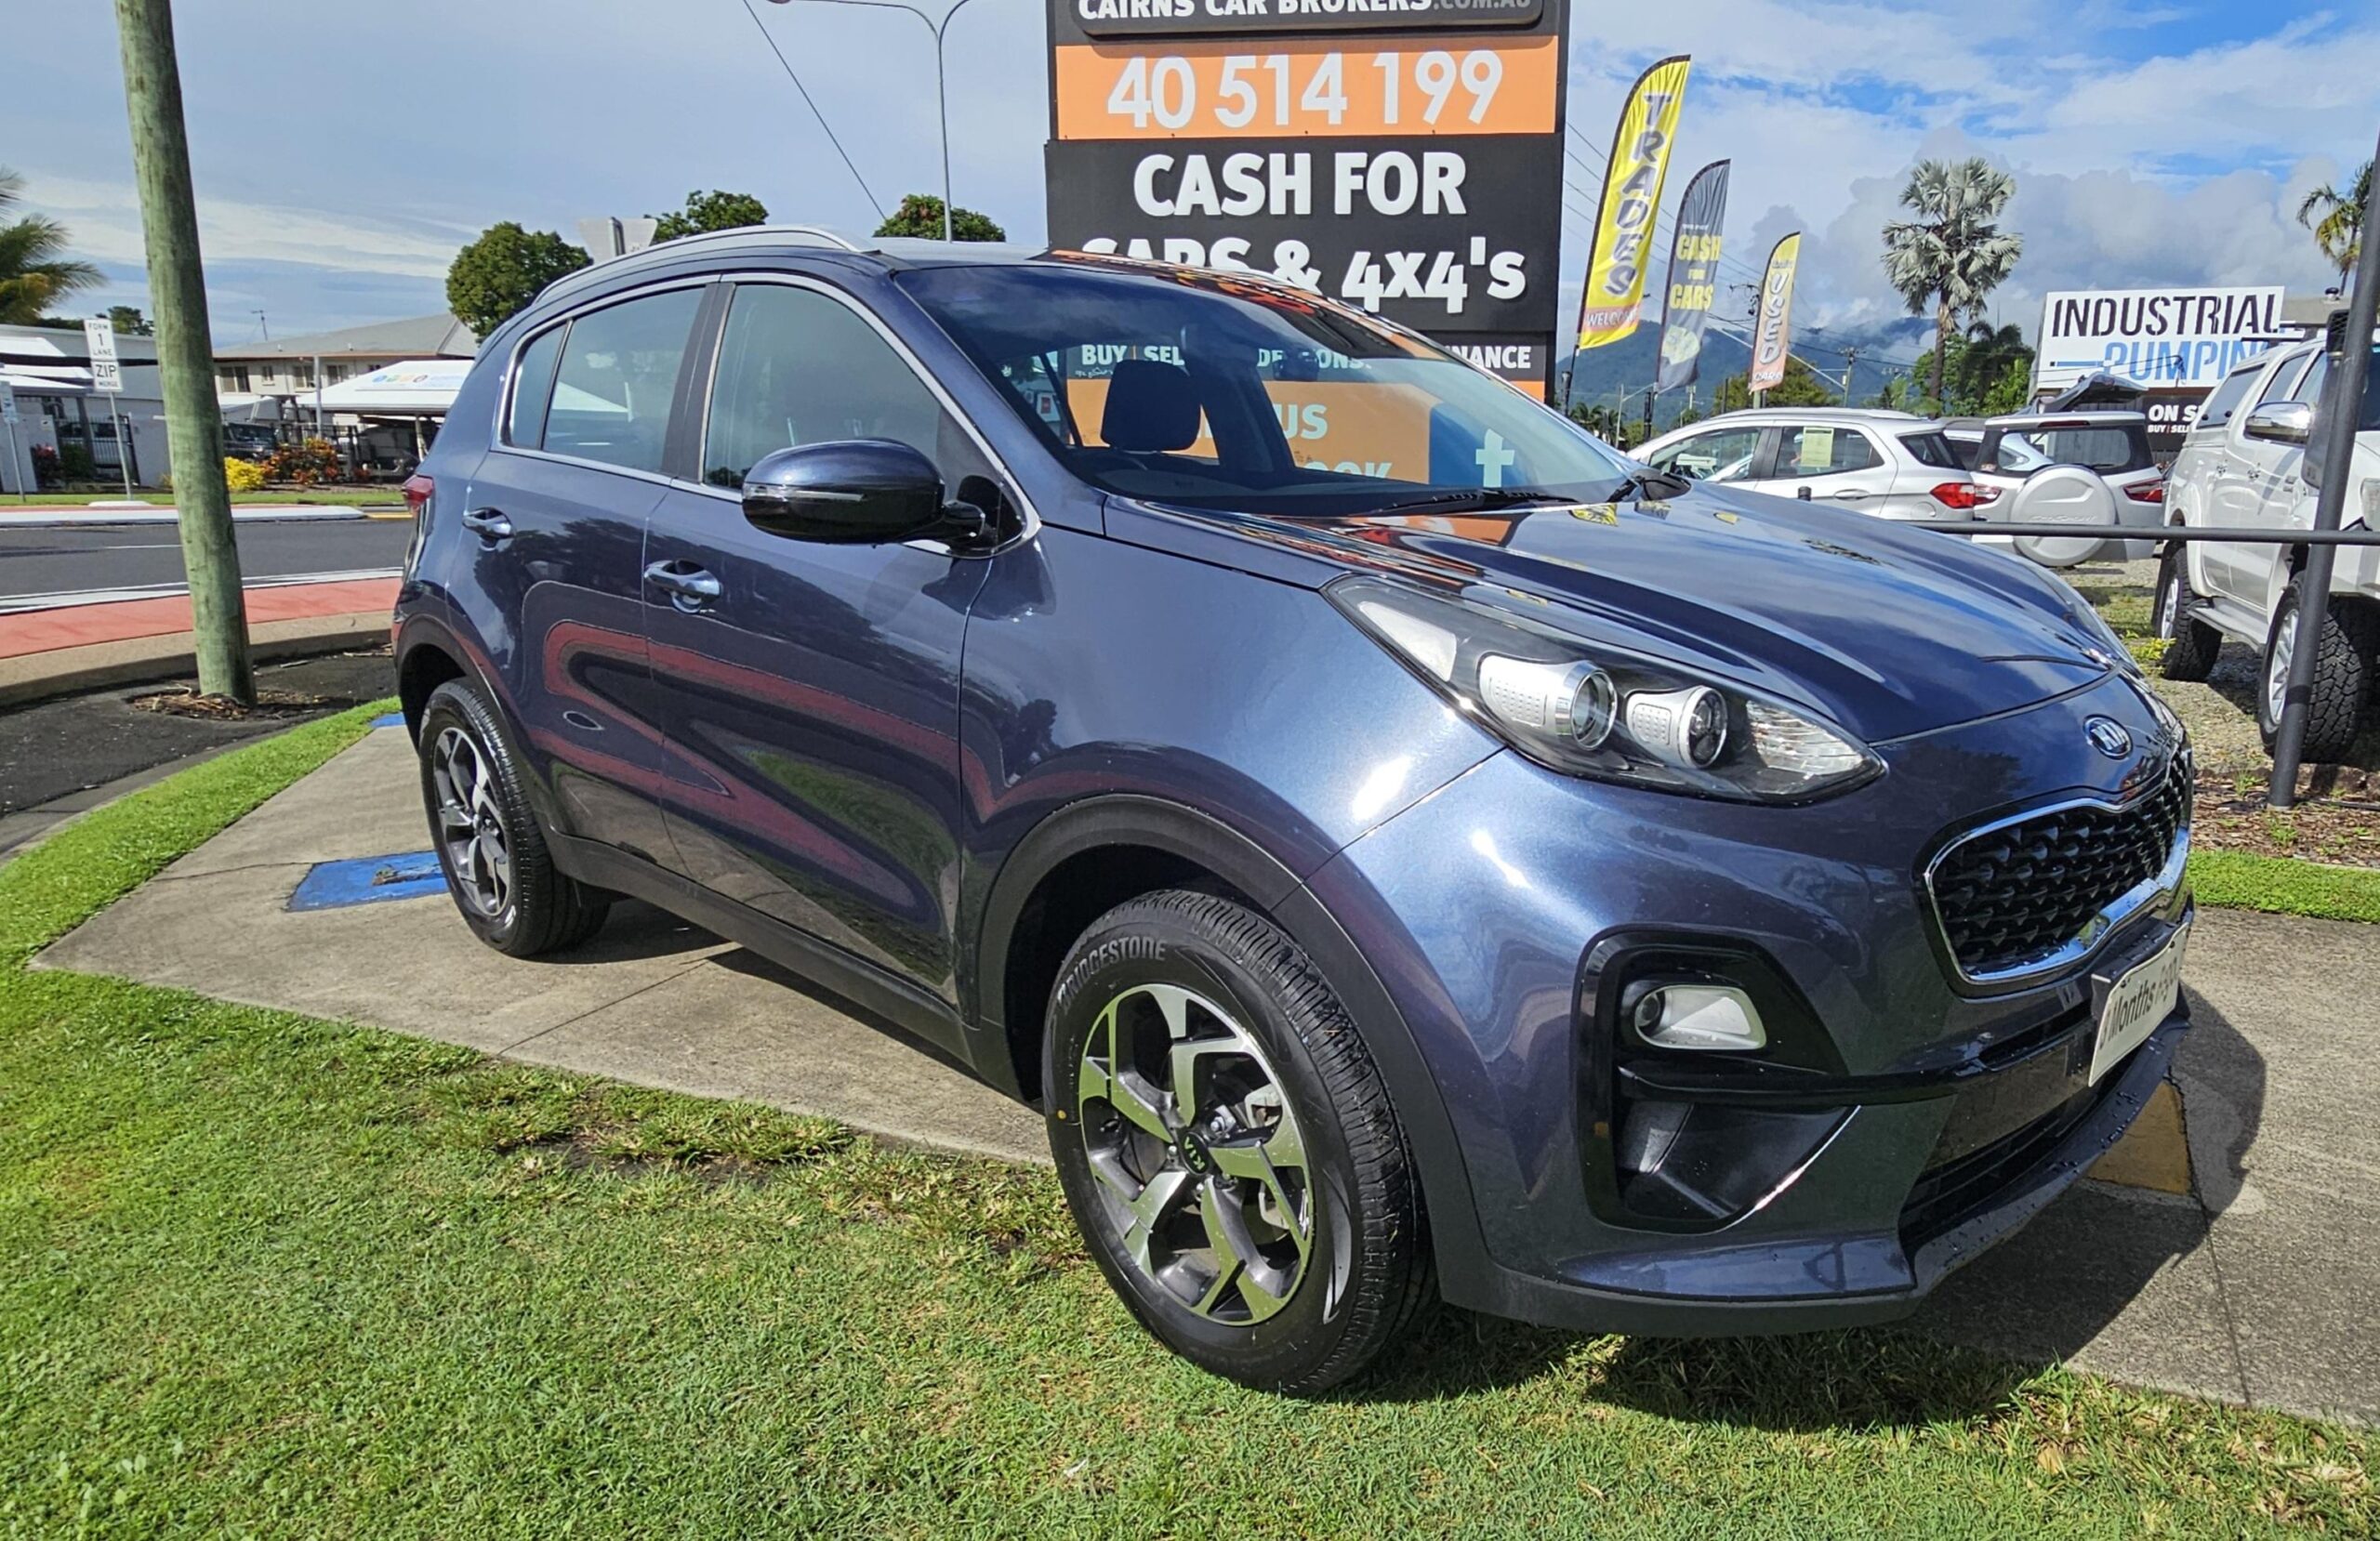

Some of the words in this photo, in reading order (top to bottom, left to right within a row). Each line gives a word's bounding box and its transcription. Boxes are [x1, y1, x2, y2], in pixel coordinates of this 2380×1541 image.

[1078, 0, 1195, 20] CAIRNS
[1107, 56, 1196, 128] 40
[1215, 53, 1347, 128] 514
[1372, 50, 1502, 125] 199
[1134, 153, 1311, 217] CASH
[1335, 151, 1466, 215] FOR
[1603, 92, 1673, 297] TRADES
[1759, 271, 1790, 364] USED
[2052, 295, 2280, 336] INDUSTRIAL
[98, 333, 103, 346] 1
[1081, 345, 1127, 365] BUY
[1144, 346, 1185, 365] SEL
[95, 363, 116, 377] ZIP
[2104, 340, 2269, 381] PUMPIN
[2148, 424, 2166, 433] BUY
[2149, 404, 2179, 421] ON
[1058, 936, 1167, 1007] BRIDGESTONE
[1183, 1136, 1206, 1170] KIA
